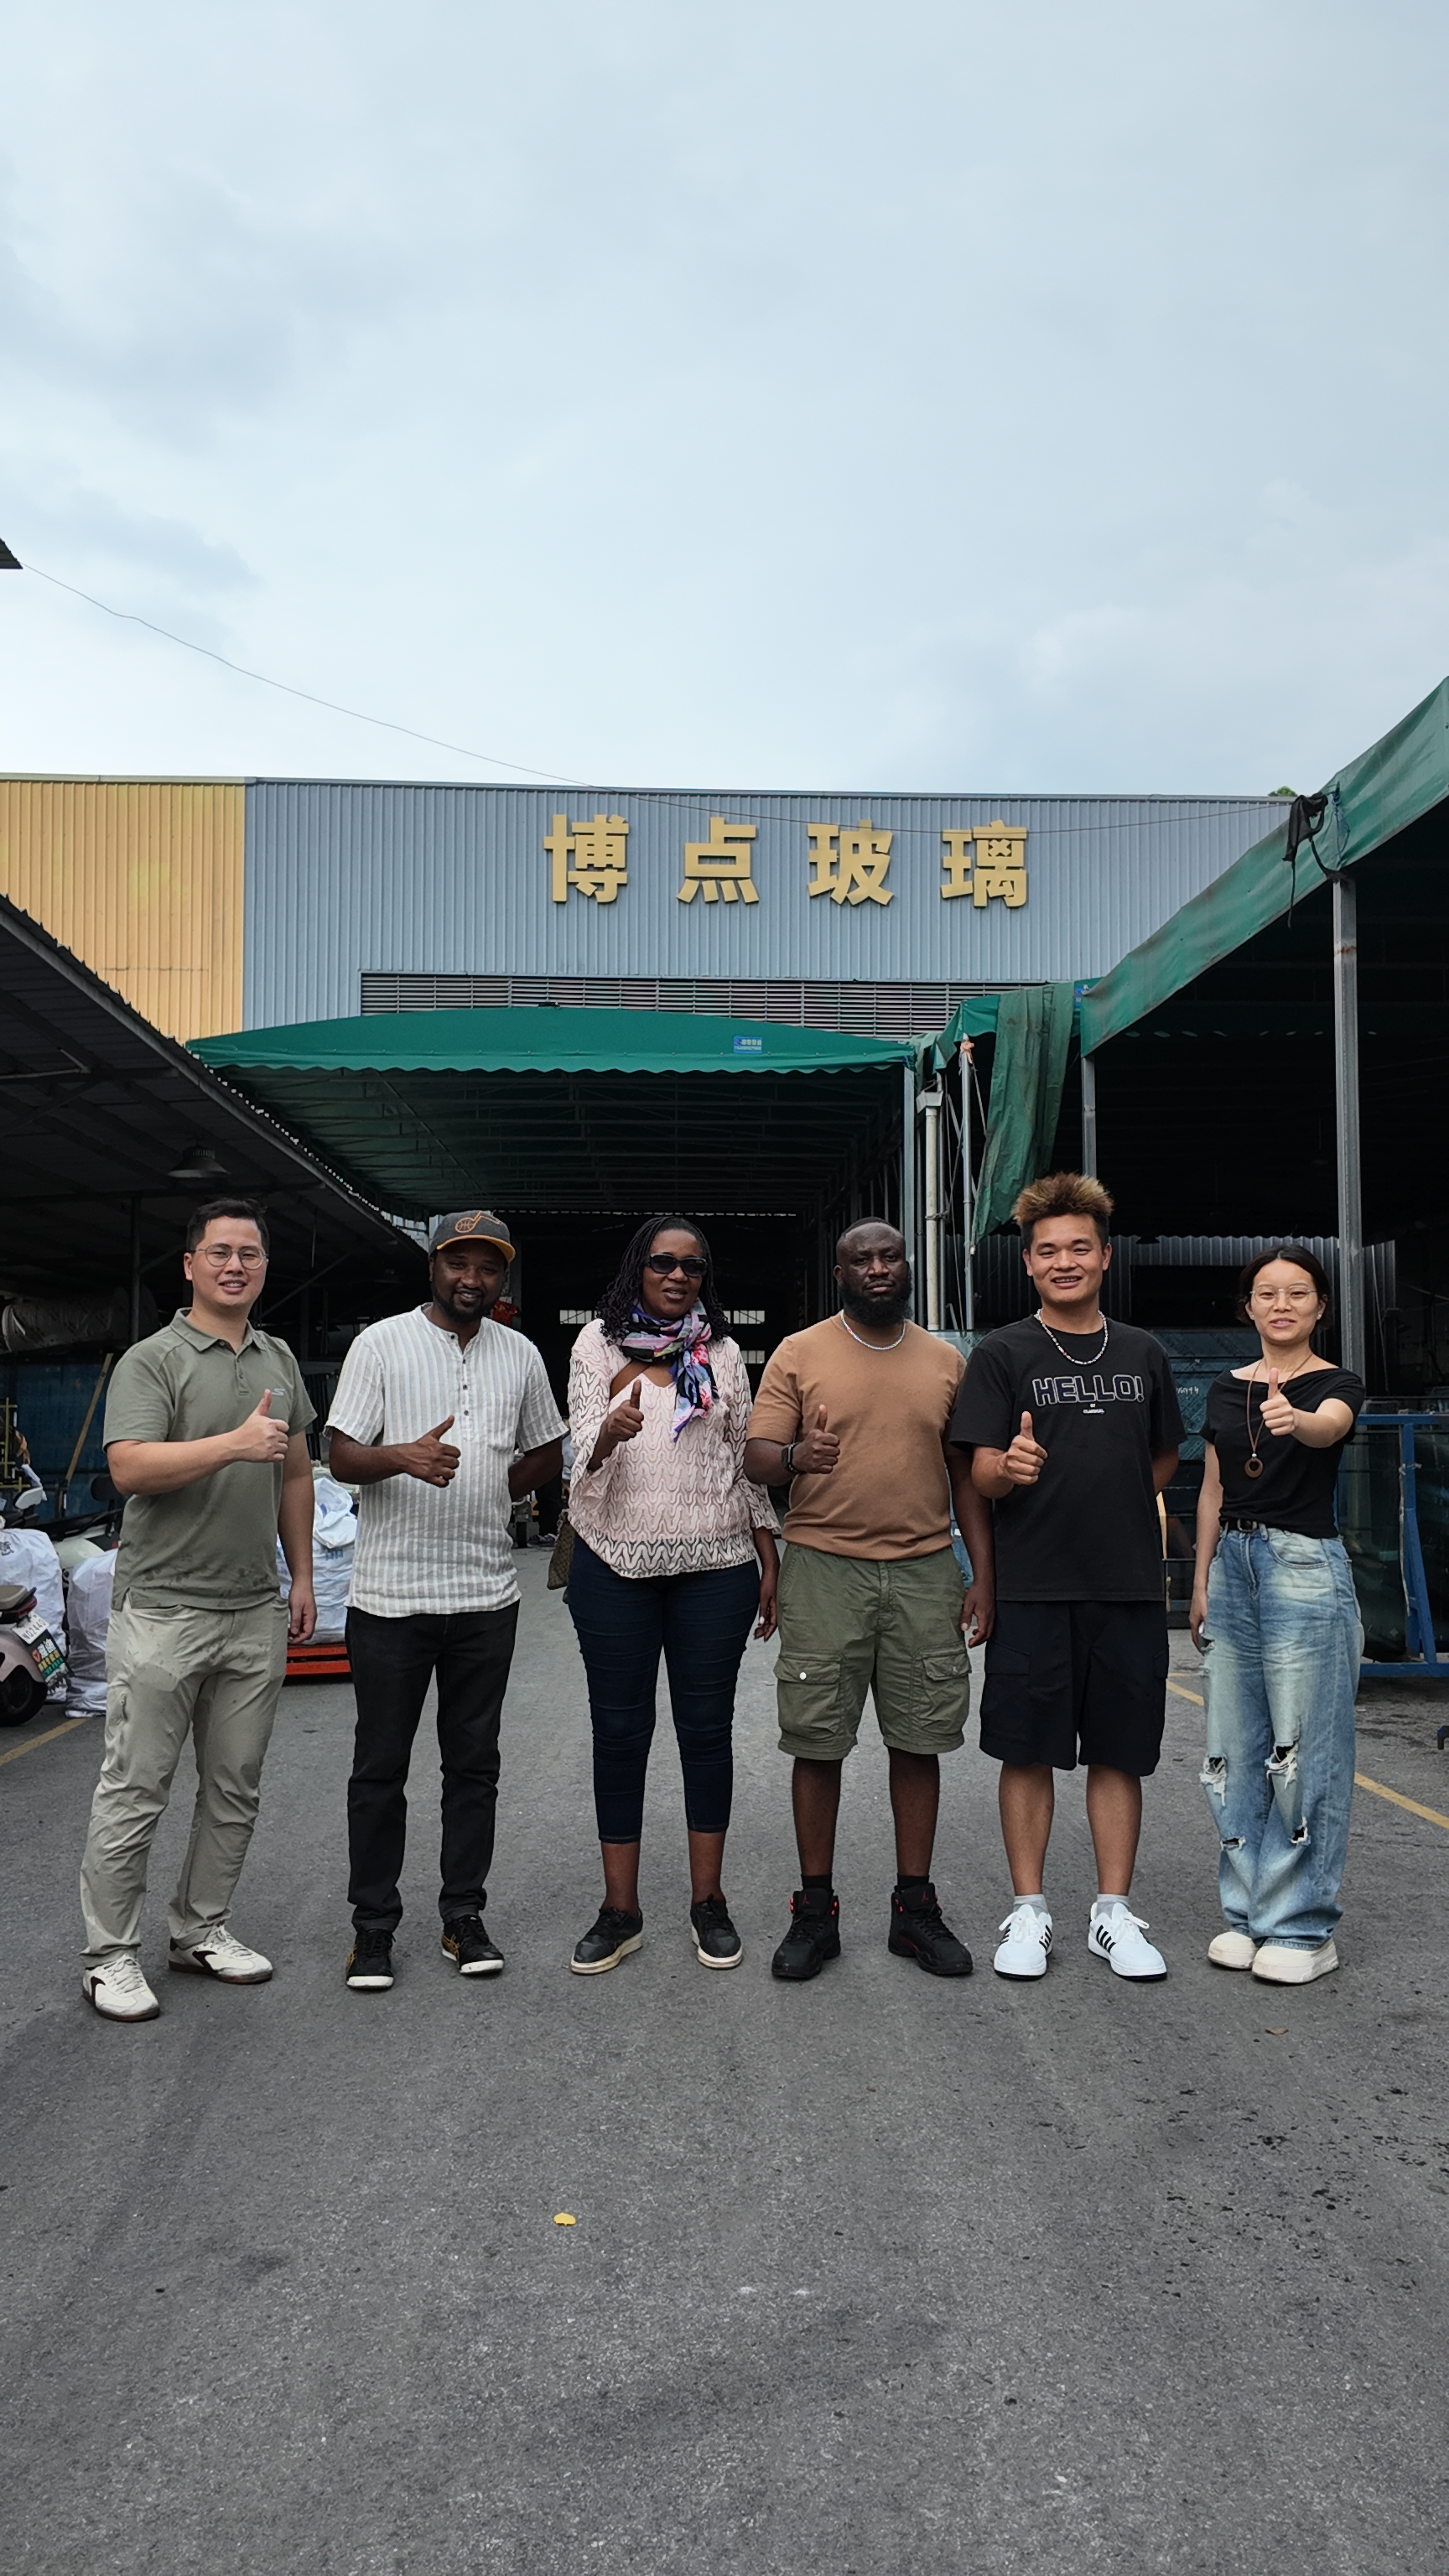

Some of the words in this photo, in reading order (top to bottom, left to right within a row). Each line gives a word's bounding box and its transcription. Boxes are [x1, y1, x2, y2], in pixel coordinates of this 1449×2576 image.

[543, 813, 1028, 907] 博点玻璃
[1032, 1374, 1145, 1406] HELLO!
